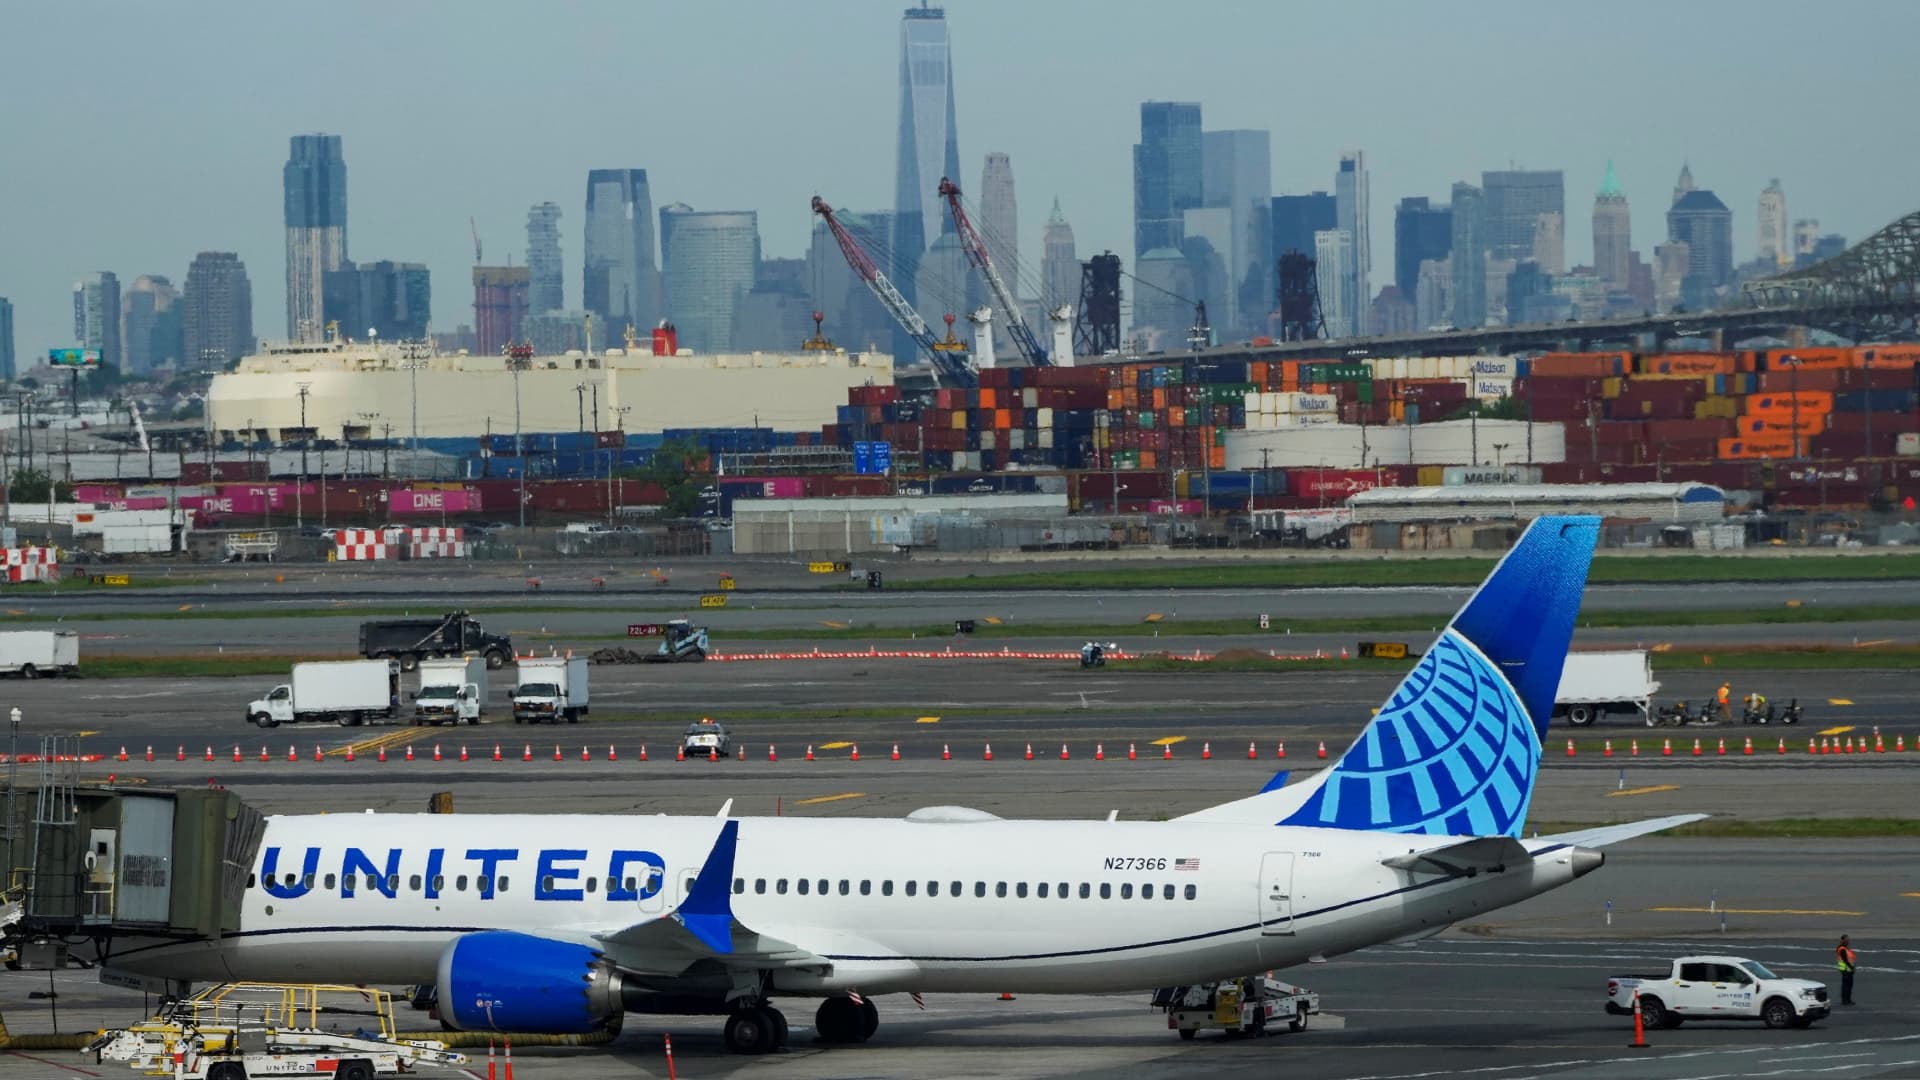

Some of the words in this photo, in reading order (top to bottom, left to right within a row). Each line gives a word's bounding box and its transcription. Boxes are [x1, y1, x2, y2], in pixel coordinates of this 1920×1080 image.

[414, 493, 442, 507] ONE
[1104, 857, 1167, 870] N27366
[261, 847, 666, 901] UNITED
